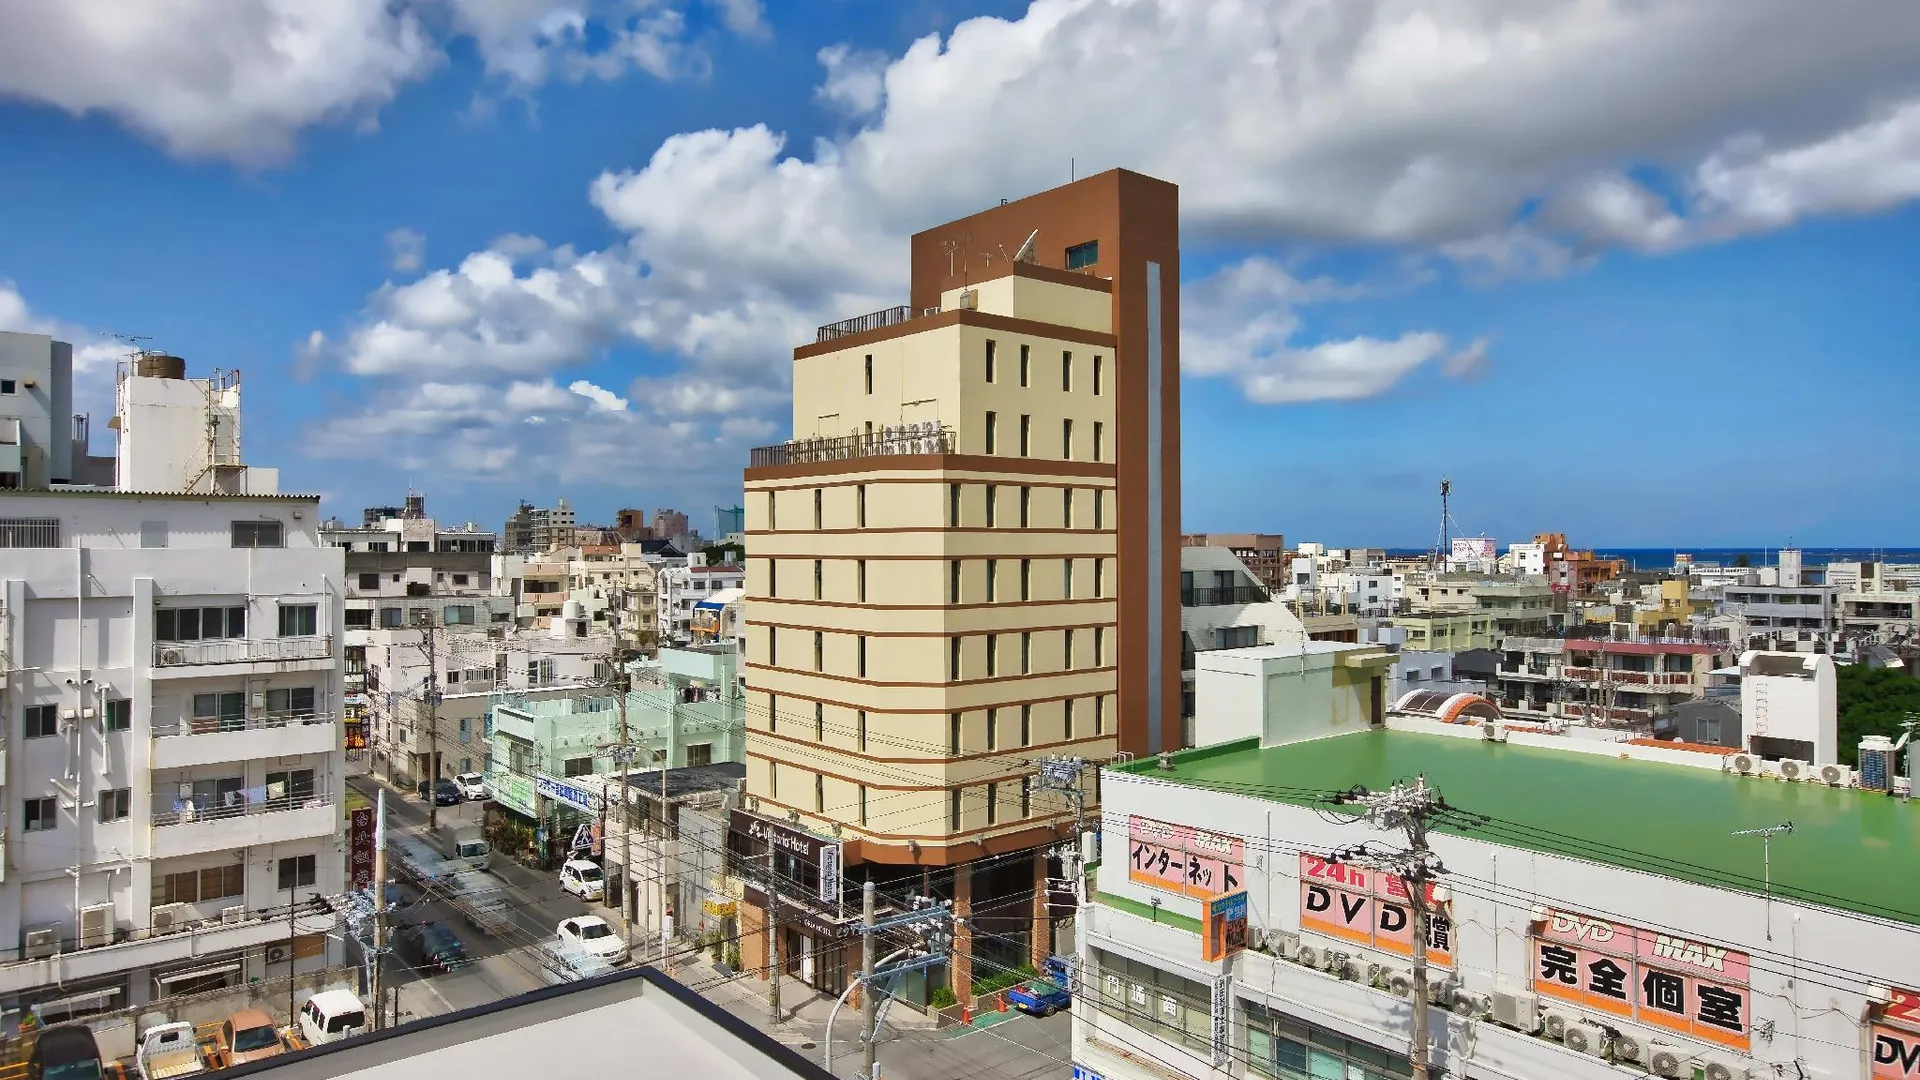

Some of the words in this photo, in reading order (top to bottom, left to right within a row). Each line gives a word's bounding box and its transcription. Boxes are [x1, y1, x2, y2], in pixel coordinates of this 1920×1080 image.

[790, 836, 810, 856] Hotel
[1131, 843, 1239, 893] インターネット
[1307, 856, 1366, 889] 24h
[1306, 885, 1408, 932] DVD
[1552, 911, 1615, 942] DVD
[1653, 934, 1728, 972] MAX
[1541, 944, 1743, 1032] 完全個室
[1874, 1034, 1920, 1075] DV
